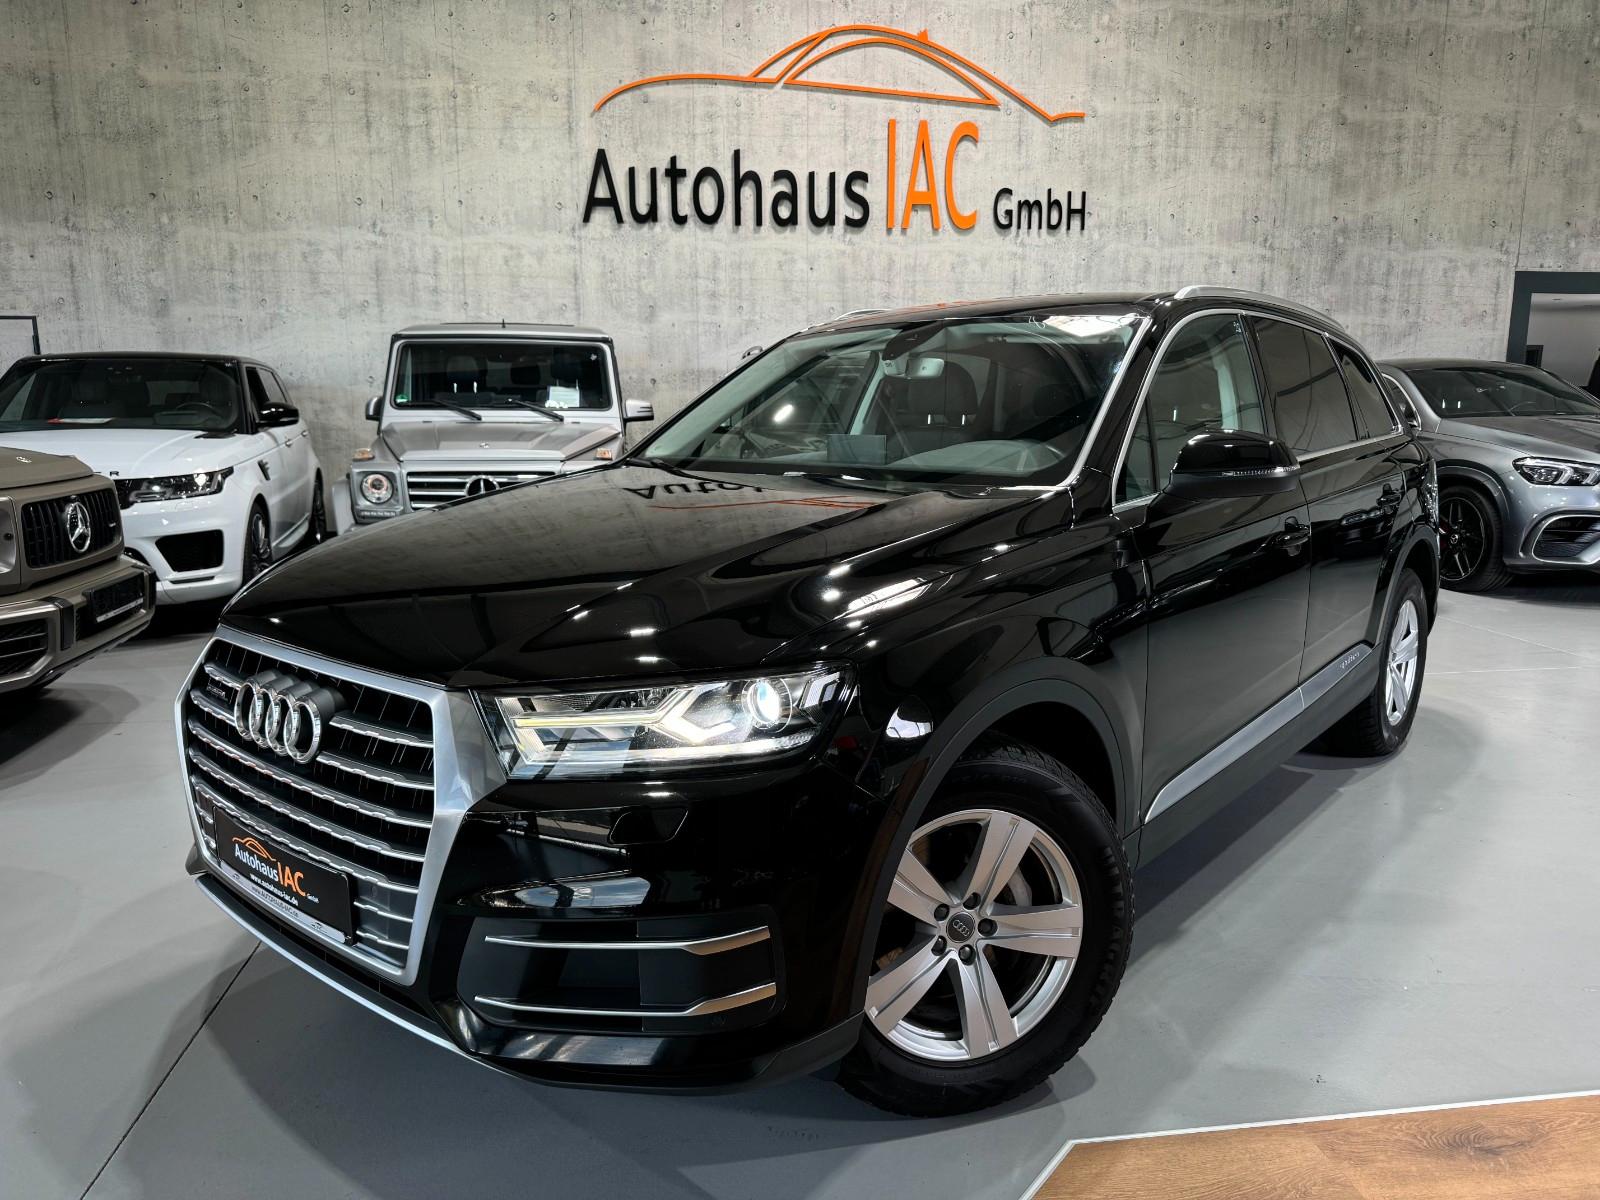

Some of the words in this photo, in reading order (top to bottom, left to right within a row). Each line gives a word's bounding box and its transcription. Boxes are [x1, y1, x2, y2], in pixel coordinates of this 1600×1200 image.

[583, 148, 870, 228] Autohaus
[887, 118, 979, 231] IAC
[993, 187, 1086, 231] GmbH
[234, 843, 279, 882] Autohaus
[277, 861, 306, 897] IAC
